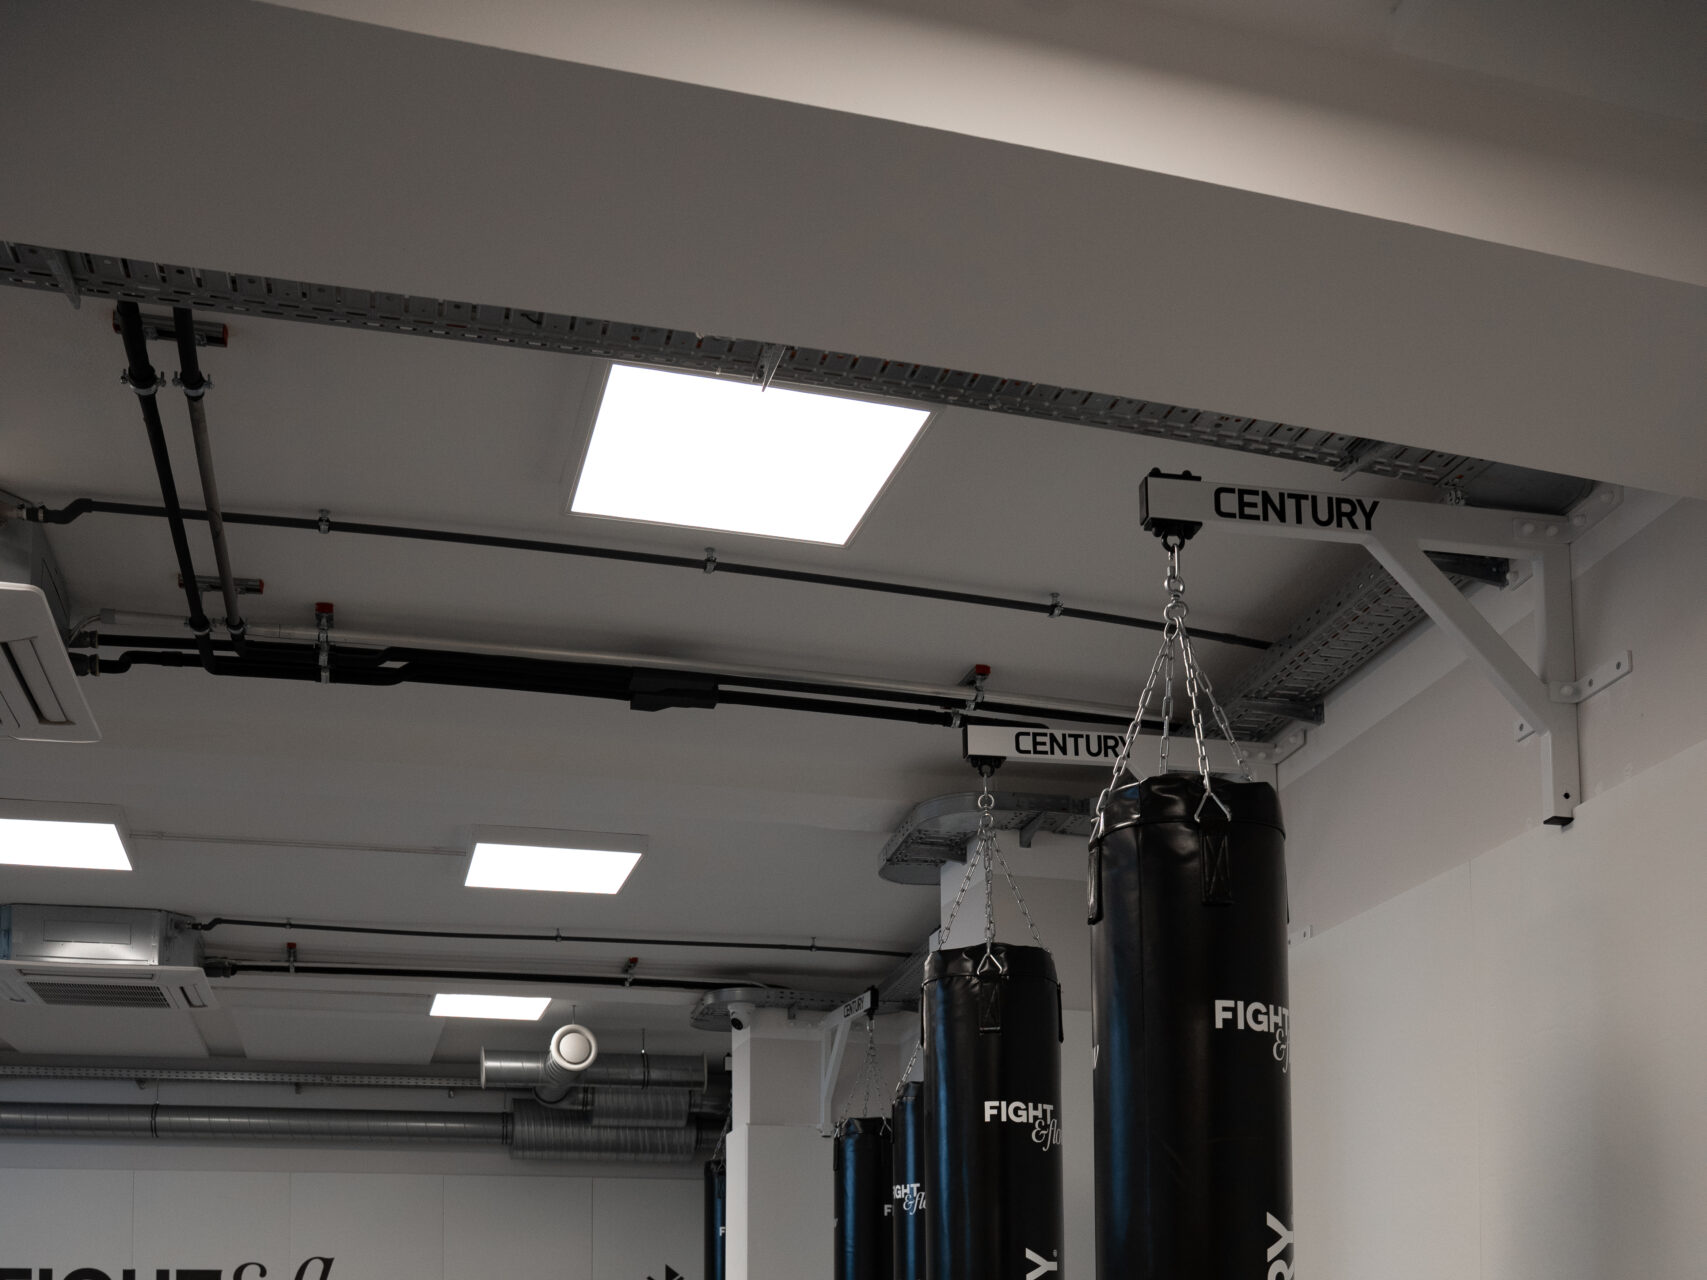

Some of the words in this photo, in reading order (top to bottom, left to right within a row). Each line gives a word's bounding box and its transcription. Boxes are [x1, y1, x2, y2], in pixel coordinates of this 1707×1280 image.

[1214, 487, 1379, 531] CENTURY
[1014, 731, 1133, 758] CENTURY
[1214, 999, 1289, 1034] FIGHT
[983, 1100, 1054, 1124] FIGHT
[1031, 1118, 1061, 1151] &flo
